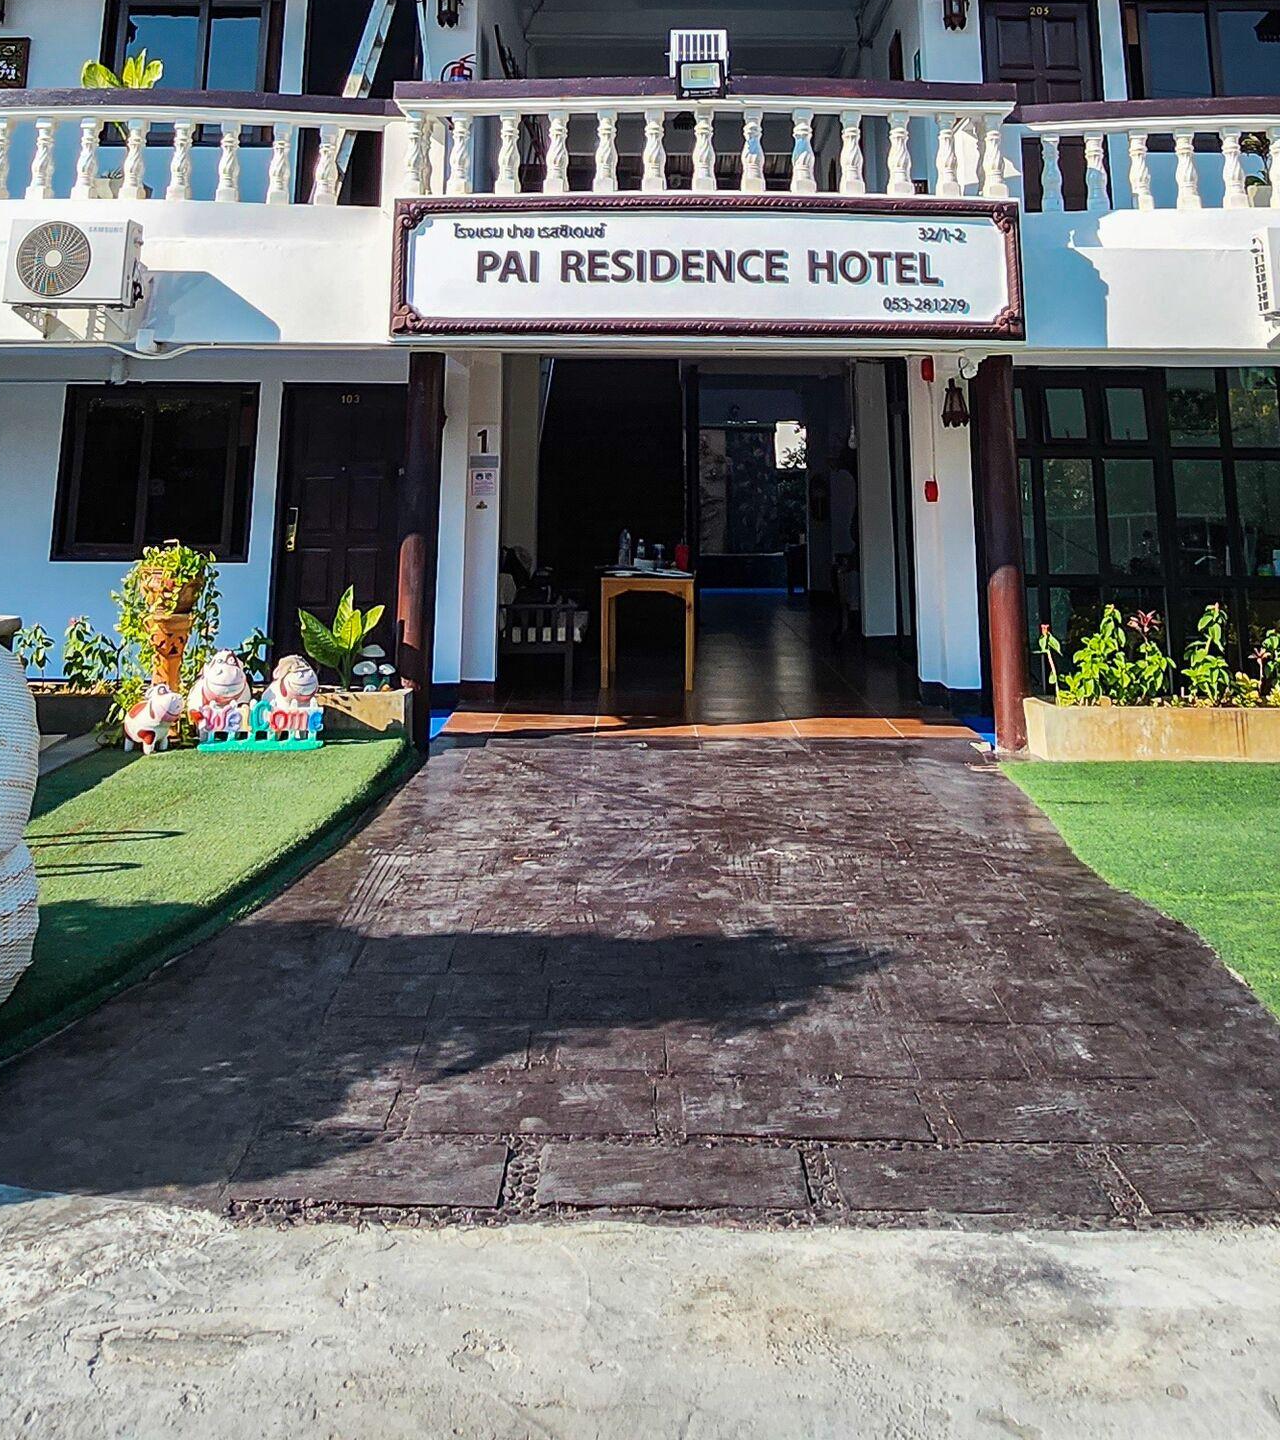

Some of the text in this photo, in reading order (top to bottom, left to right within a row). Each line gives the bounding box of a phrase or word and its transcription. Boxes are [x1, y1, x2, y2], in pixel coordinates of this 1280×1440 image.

[1030, 6, 1049, 15] 205
[453, 223, 504, 239] โรงแรม
[507, 224, 534, 239] ปาย
[918, 227, 967, 243] 32/1-2
[476, 249, 944, 287] PAI RESIDENCE HOTEL
[883, 297, 970, 314] 053-281279
[341, 394, 360, 404] 103
[477, 429, 488, 453] 1
